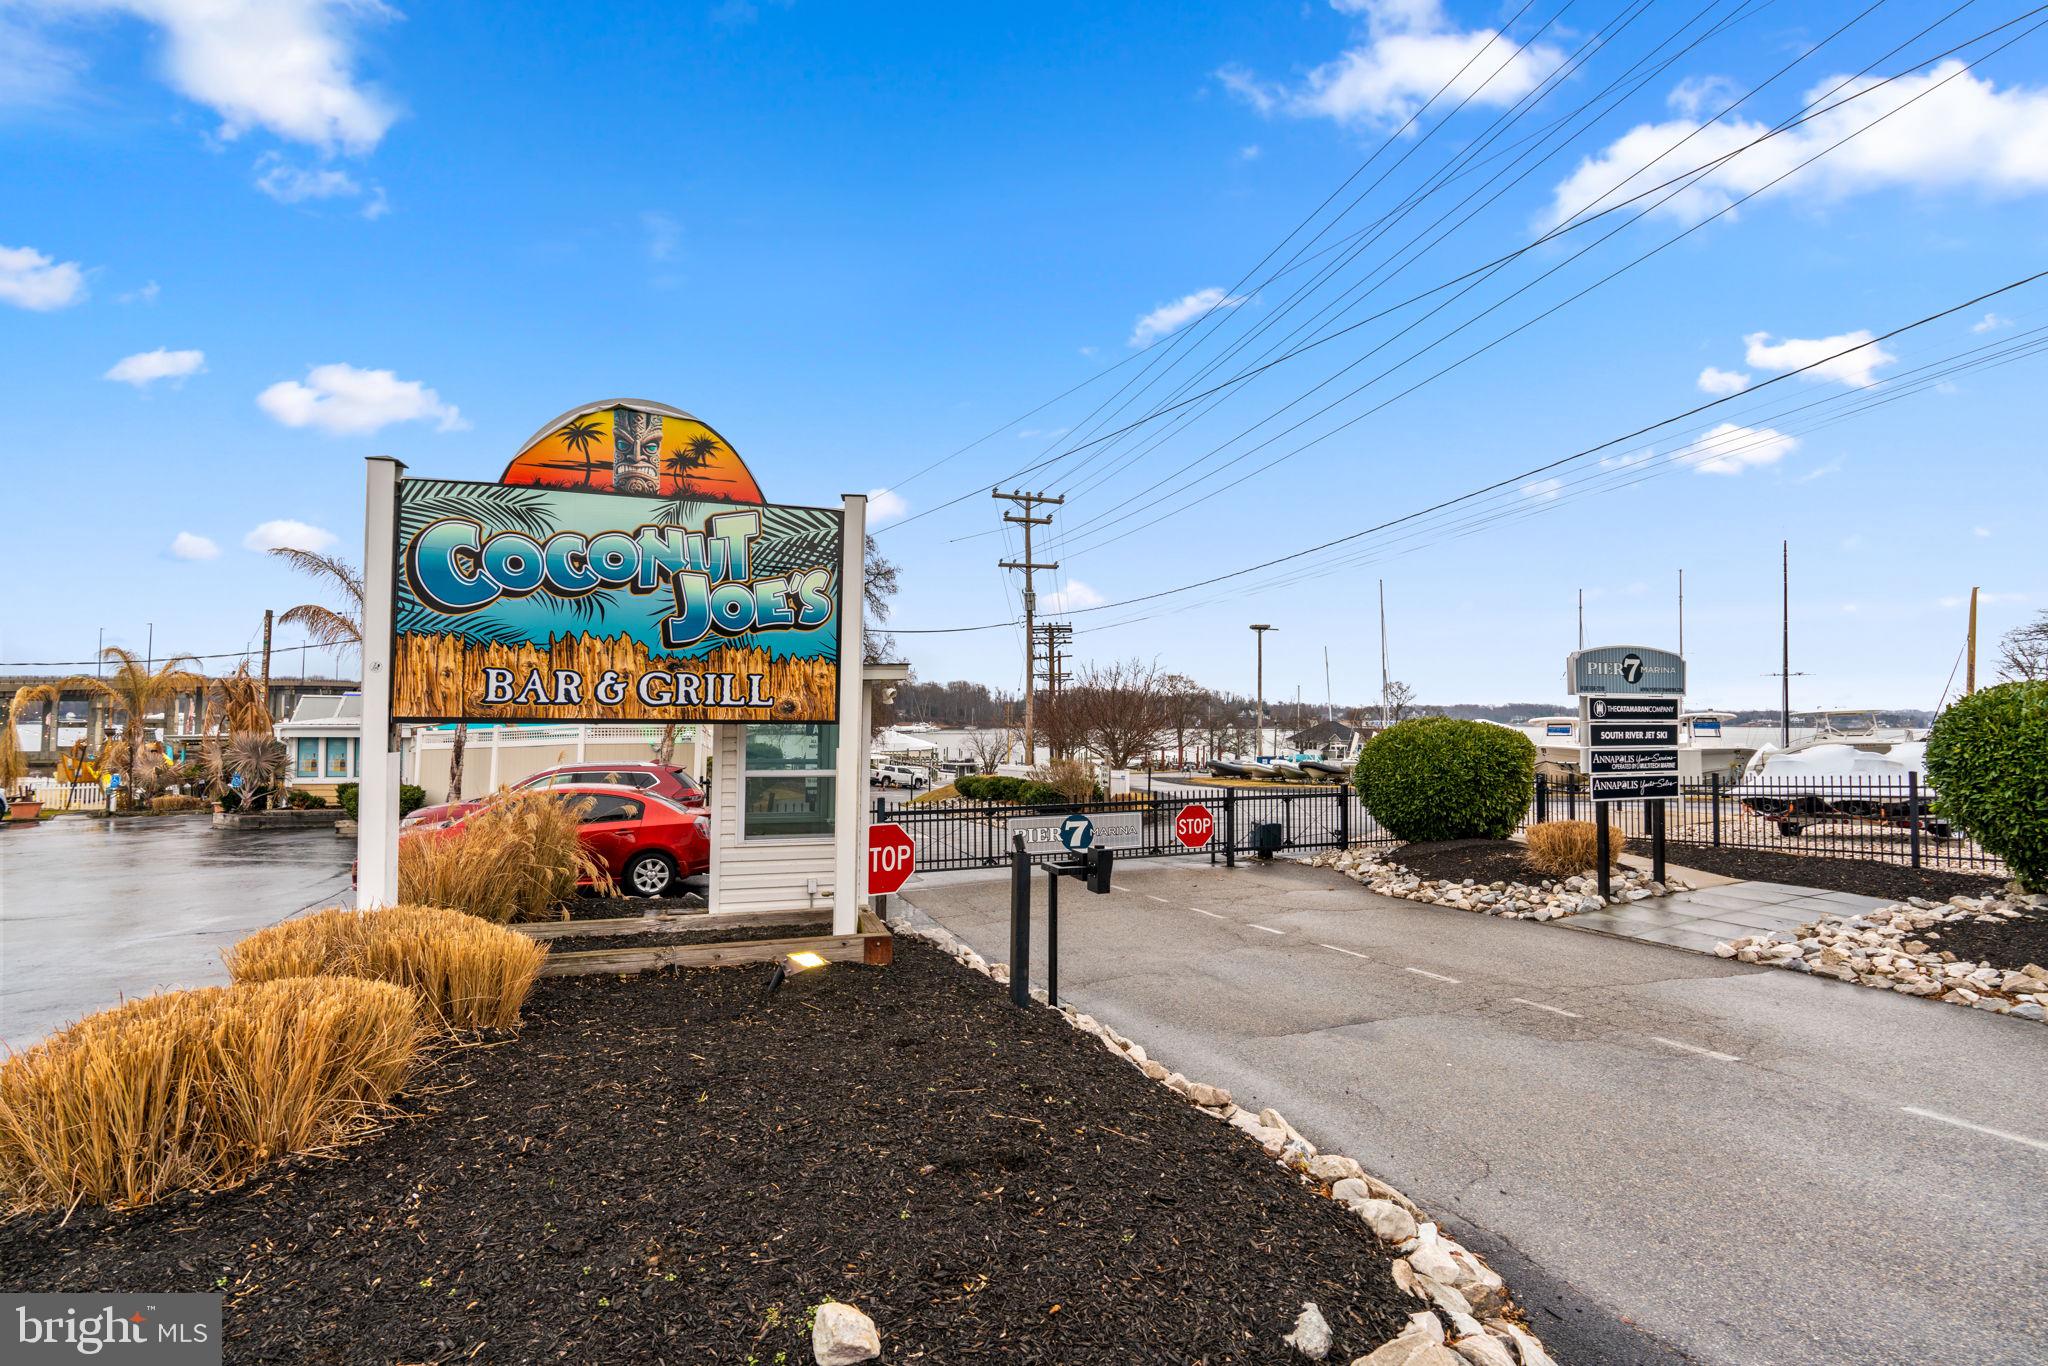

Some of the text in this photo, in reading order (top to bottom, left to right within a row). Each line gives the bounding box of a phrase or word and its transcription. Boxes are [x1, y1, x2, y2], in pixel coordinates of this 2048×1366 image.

[408, 511, 762, 613] COCONUT
[663, 570, 834, 647] JOE'S
[1587, 658, 1676, 682] PIER 7 MARINA
[483, 668, 775, 708] BAR & GRILL
[1600, 731, 1668, 740] SOUTH RIVER JET SKI
[1593, 753, 1635, 764] ANNAPOLIS
[1594, 779, 1639, 791] ANNAPOLIS
[1065, 820, 1089, 847] 7
[1089, 825, 1138, 837] MARINA
[1178, 818, 1212, 835] STOP
[869, 845, 911, 873] TOP
